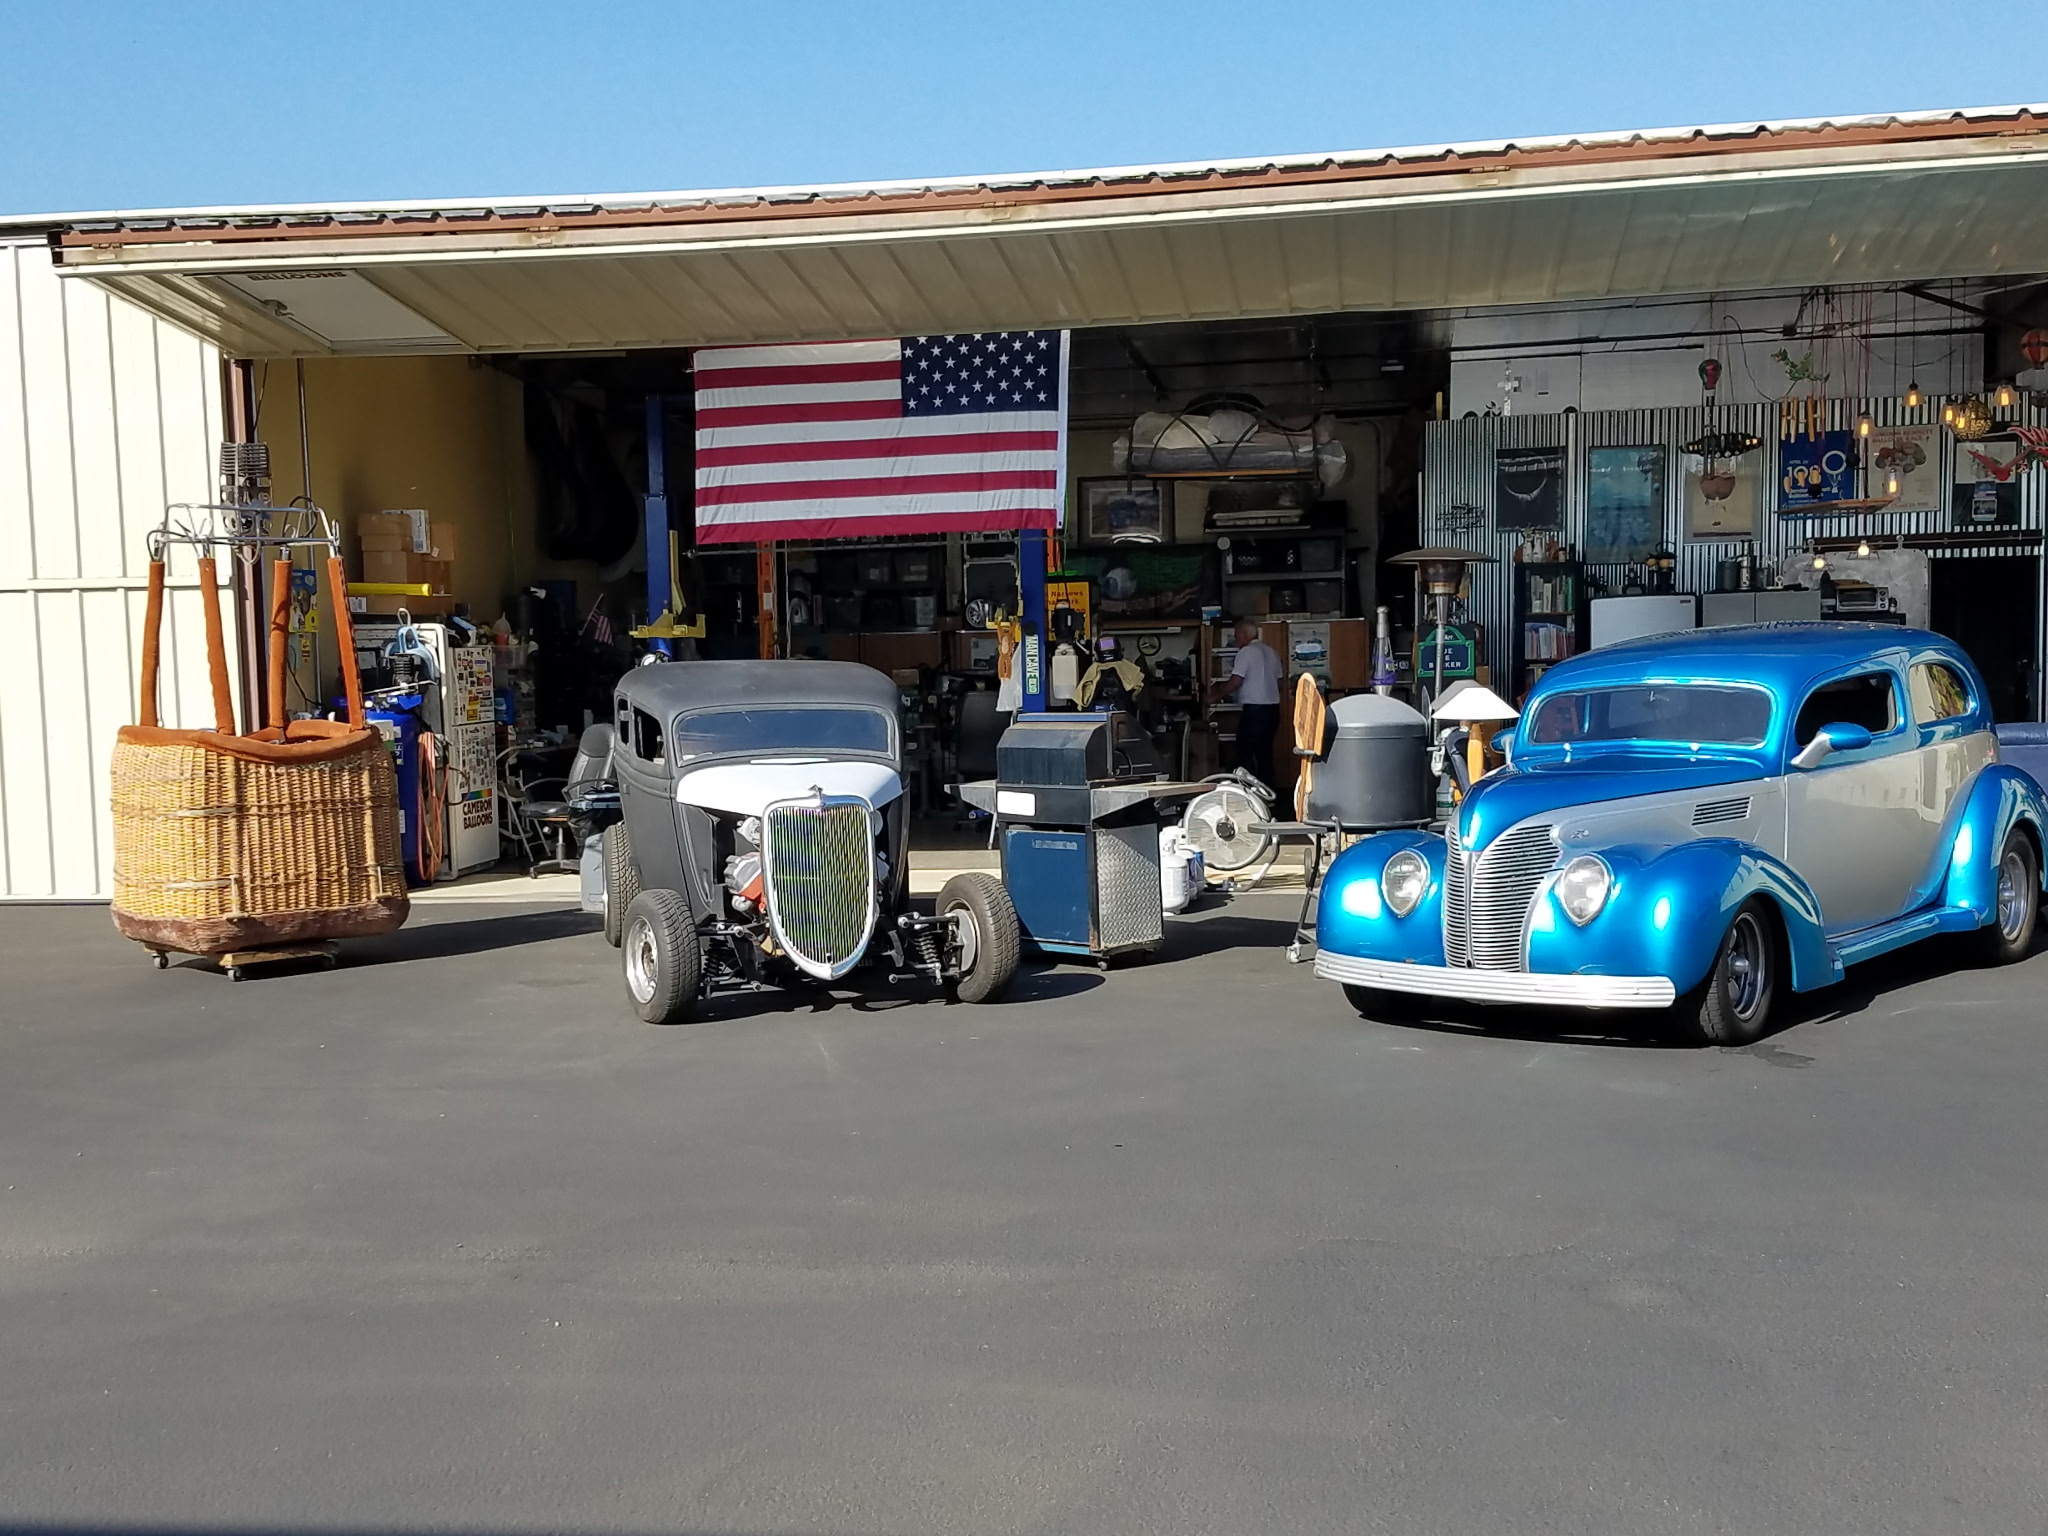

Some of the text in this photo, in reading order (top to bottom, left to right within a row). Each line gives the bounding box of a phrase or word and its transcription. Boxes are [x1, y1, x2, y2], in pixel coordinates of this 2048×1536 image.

[1026, 636, 1039, 655] MAN
[1428, 661, 1461, 669] BKER
[463, 798, 493, 816] CAMERON
[463, 811, 493, 830] BALLOONS
